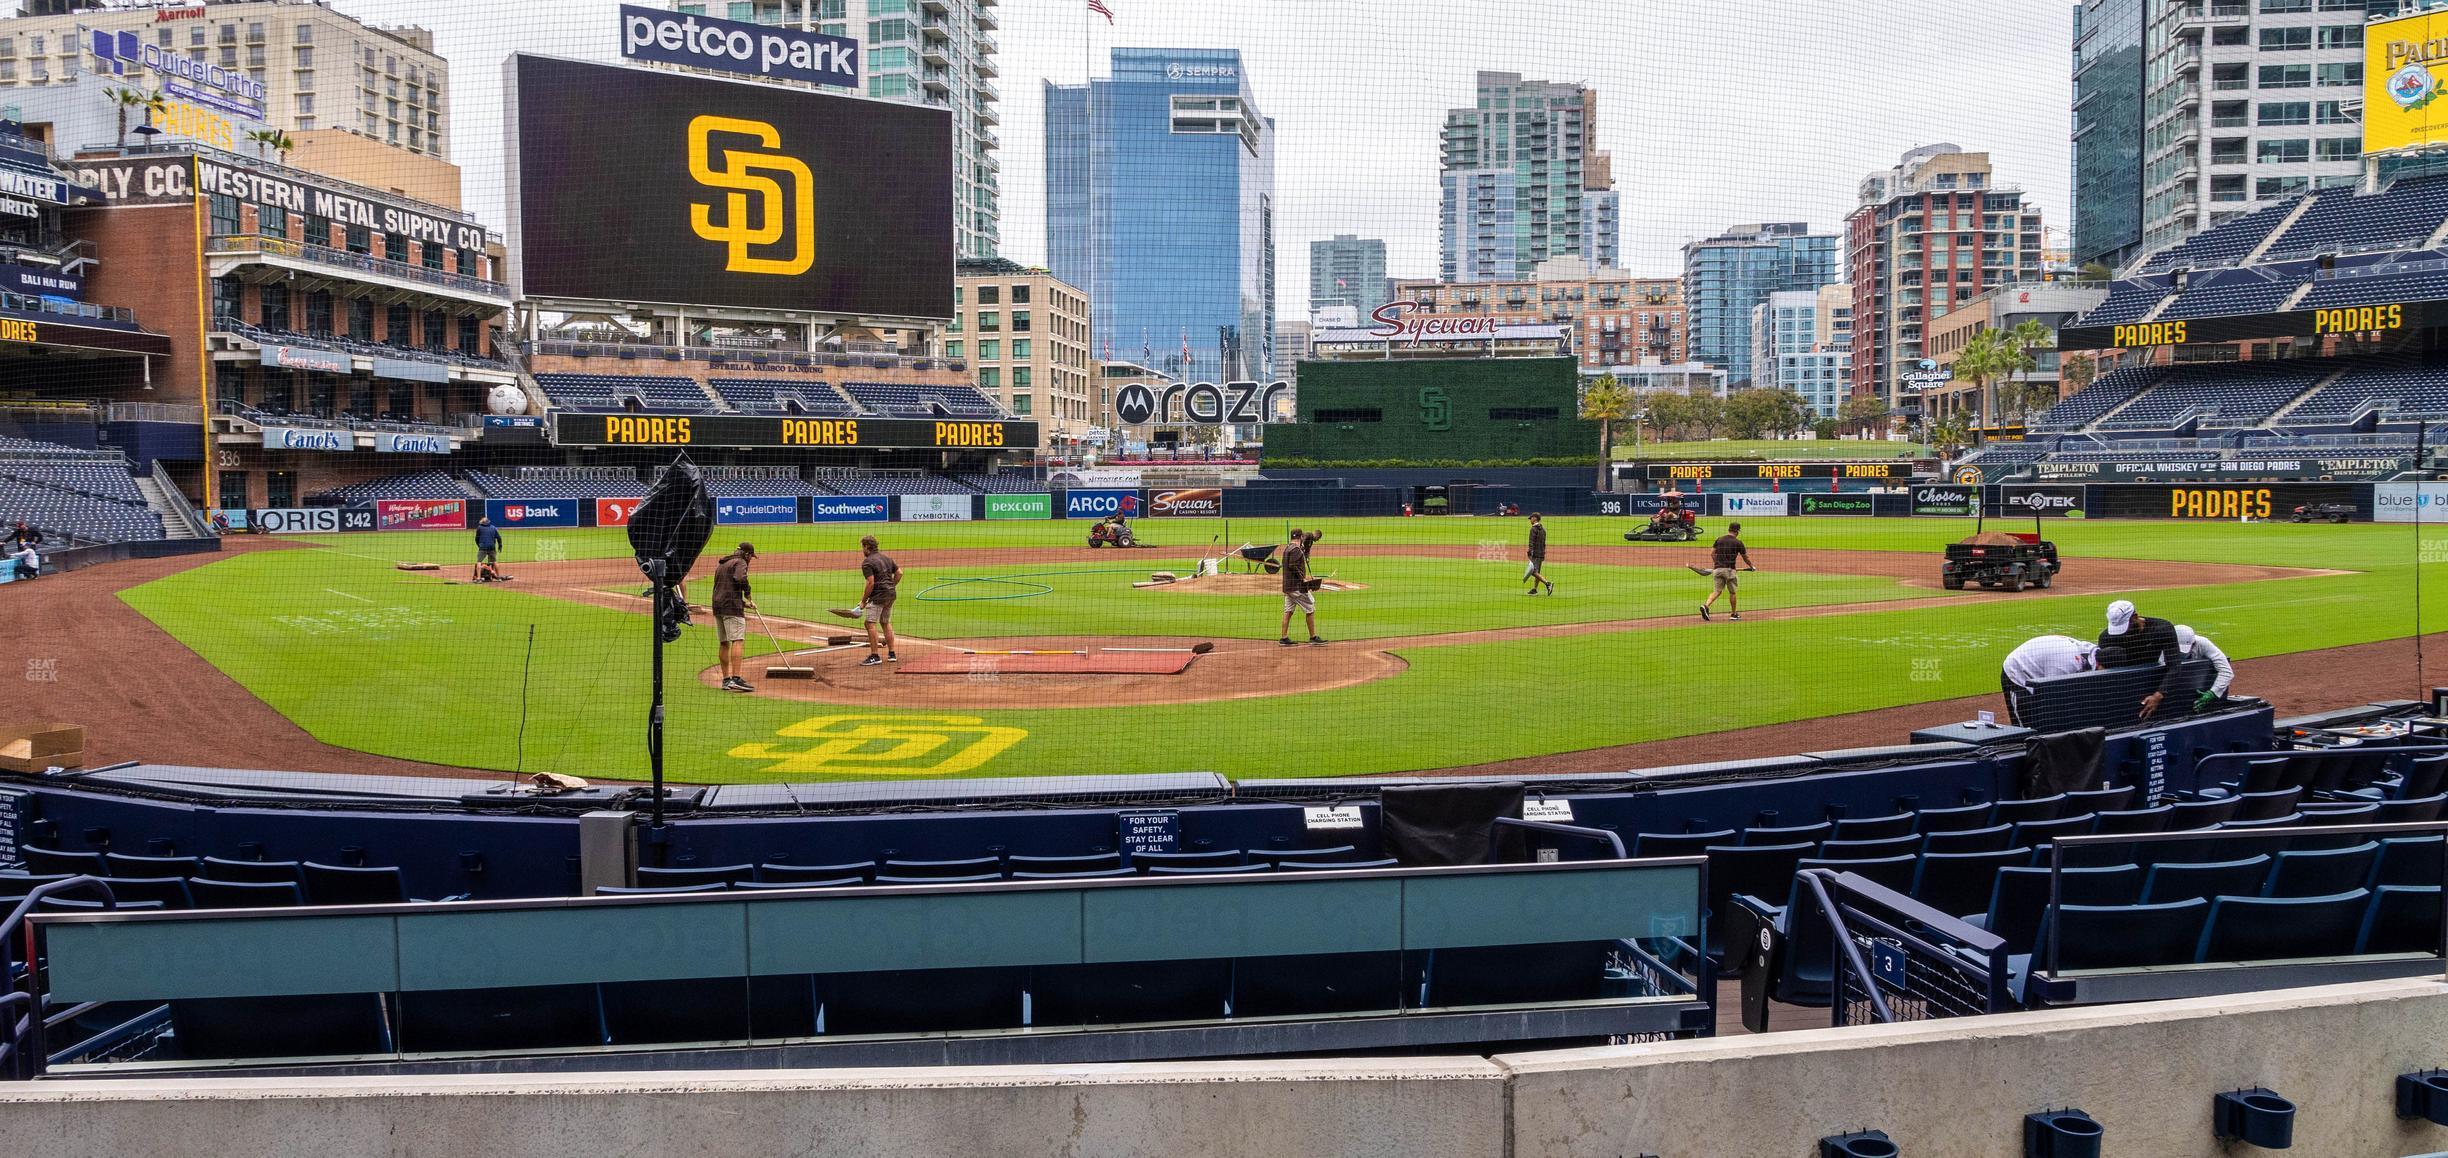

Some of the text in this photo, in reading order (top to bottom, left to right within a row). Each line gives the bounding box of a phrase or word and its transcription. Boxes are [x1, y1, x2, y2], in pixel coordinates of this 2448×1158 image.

[155, 7, 205, 22] Marriott
[626, 15, 855, 76] petco park
[144, 44, 263, 99] QuidelOrtho
[1186, 66, 1235, 77] SEMPRA
[144, 165, 194, 197] CO.
[198, 161, 486, 253] WESTERN METAL SUPPLY CO.
[21, 274, 77, 291] BALI HAI RUM
[1370, 301, 1499, 347] Sycuan
[2315, 304, 2401, 334] PADRES
[2113, 321, 2187, 348] PADRES
[709, 362, 751, 371] ESTRELLA
[753, 364, 786, 372] JALISCO
[1901, 371, 1951, 382] Gallagher
[1908, 380, 1944, 389] Square
[1161, 382, 1287, 424] razr
[606, 416, 691, 444] PADRES
[782, 419, 858, 446] PADRES
[935, 422, 1004, 447] PADRES
[284, 429, 339, 449] Canel's
[392, 434, 439, 453] Canel's
[219, 450, 240, 467] 336
[2115, 463, 2155, 472] OFFICIAL
[2156, 462, 2198, 472] WHISKEY
[2220, 462, 2238, 471] SAN
[2239, 461, 2265, 471] DIEGO
[2267, 460, 2301, 471] PADRES
[2318, 460, 2399, 470] TEMPLETON
[1846, 465, 1889, 477] PADRES
[2036, 463, 2100, 473] TEMPLETON
[1746, 497, 1784, 506] National
[1918, 487, 1966, 503] Chosen
[2379, 493, 2413, 506] blue
[736, 504, 793, 516] QuidelOrtho
[818, 503, 875, 515] Southwest
[1069, 497, 1118, 512] ARCO
[1153, 491, 1215, 515] Sycuan
[1601, 501, 1621, 514] 396
[1637, 500, 1649, 508] UC
[1650, 500, 1661, 508] San
[1819, 501, 1871, 510] San Diego Zoo
[2171, 488, 2272, 519] PADRES
[507, 505, 559, 518] us bank
[261, 510, 336, 532] ORIS
[345, 512, 371, 528] 342
[1147, 816, 1169, 824] YOUR
[1132, 826, 1166, 834] SAFETY,
[1125, 834, 1174, 844] STAY CLEAR
[1884, 956, 1892, 972] 3
